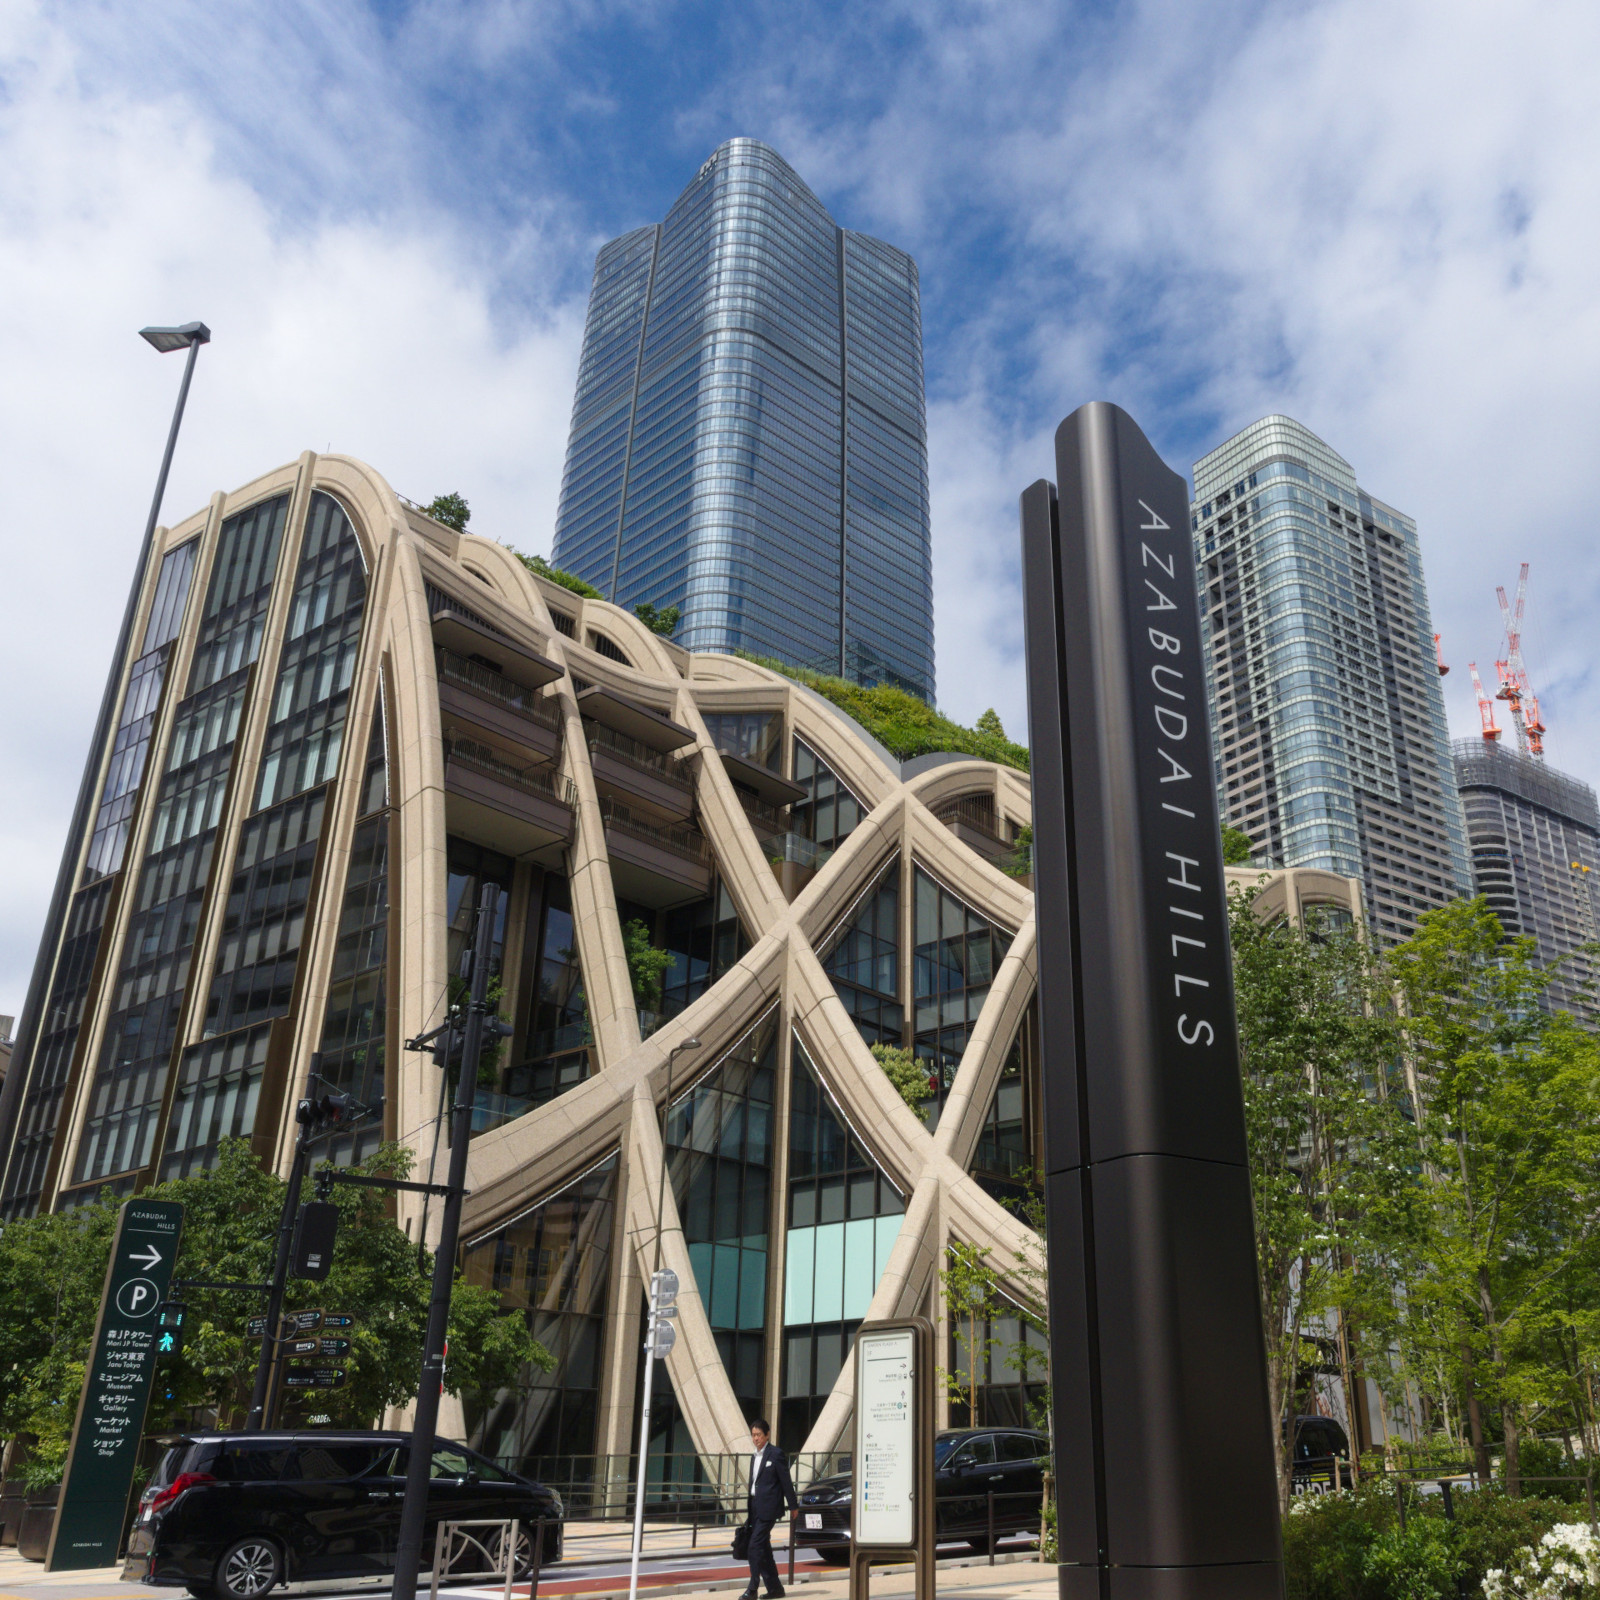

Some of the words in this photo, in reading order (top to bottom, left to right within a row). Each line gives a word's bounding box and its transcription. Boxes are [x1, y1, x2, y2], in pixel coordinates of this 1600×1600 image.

[1138, 499, 1196, 819] AZABUDAI
[1165, 851, 1215, 1047] HILLS
[131, 1211, 167, 1220] AZABUDAI
[156, 1222, 176, 1230] HILLS
[130, 1285, 147, 1310] P
[132, 1340, 150, 1348] Tower
[106, 1351, 146, 1361] ジャヌ東京
[123, 1361, 141, 1369] Tokyo
[99, 1372, 143, 1382] ミュージアム
[98, 1394, 135, 1403] ギャラリー
[103, 1404, 127, 1412] Gallery
[94, 1416, 131, 1426] マーケット
[99, 1426, 122, 1434] Market
[93, 1438, 124, 1448] ショップ
[98, 1448, 114, 1456] Shop
